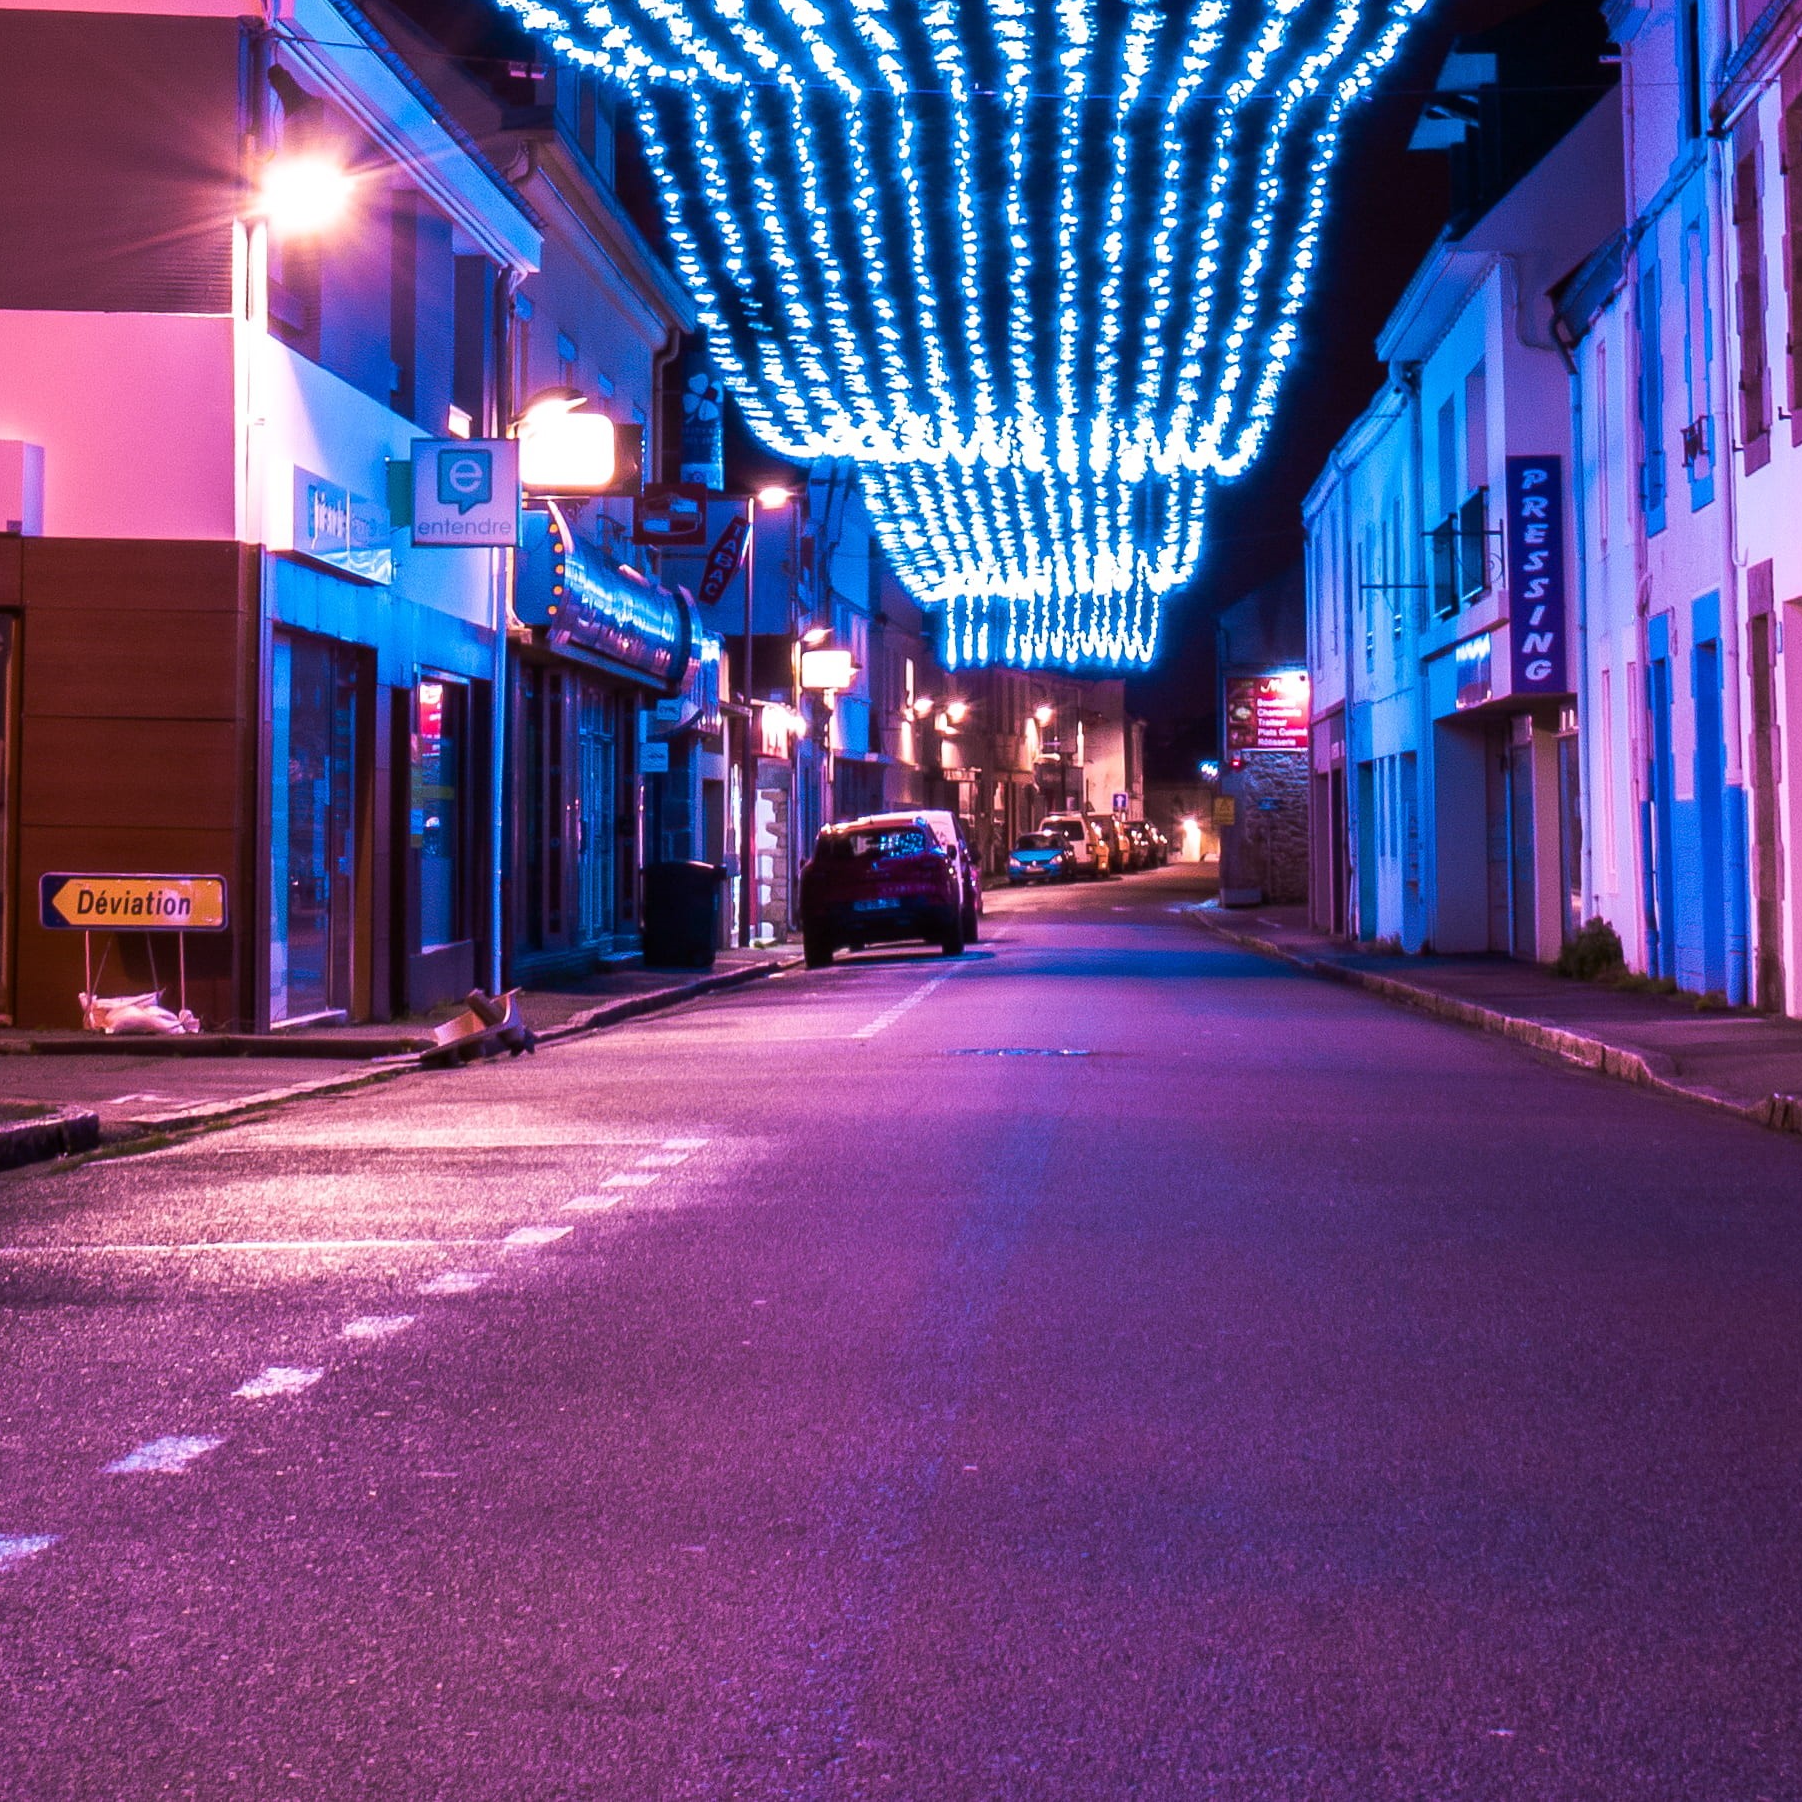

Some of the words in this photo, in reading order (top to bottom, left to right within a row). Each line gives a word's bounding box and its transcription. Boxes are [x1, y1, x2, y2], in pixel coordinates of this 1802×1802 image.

[418, 518, 512, 536] entendre
[704, 522, 745, 596] TABAC
[1521, 468, 1554, 681] PRESSING
[77, 889, 191, 916] Déviation
